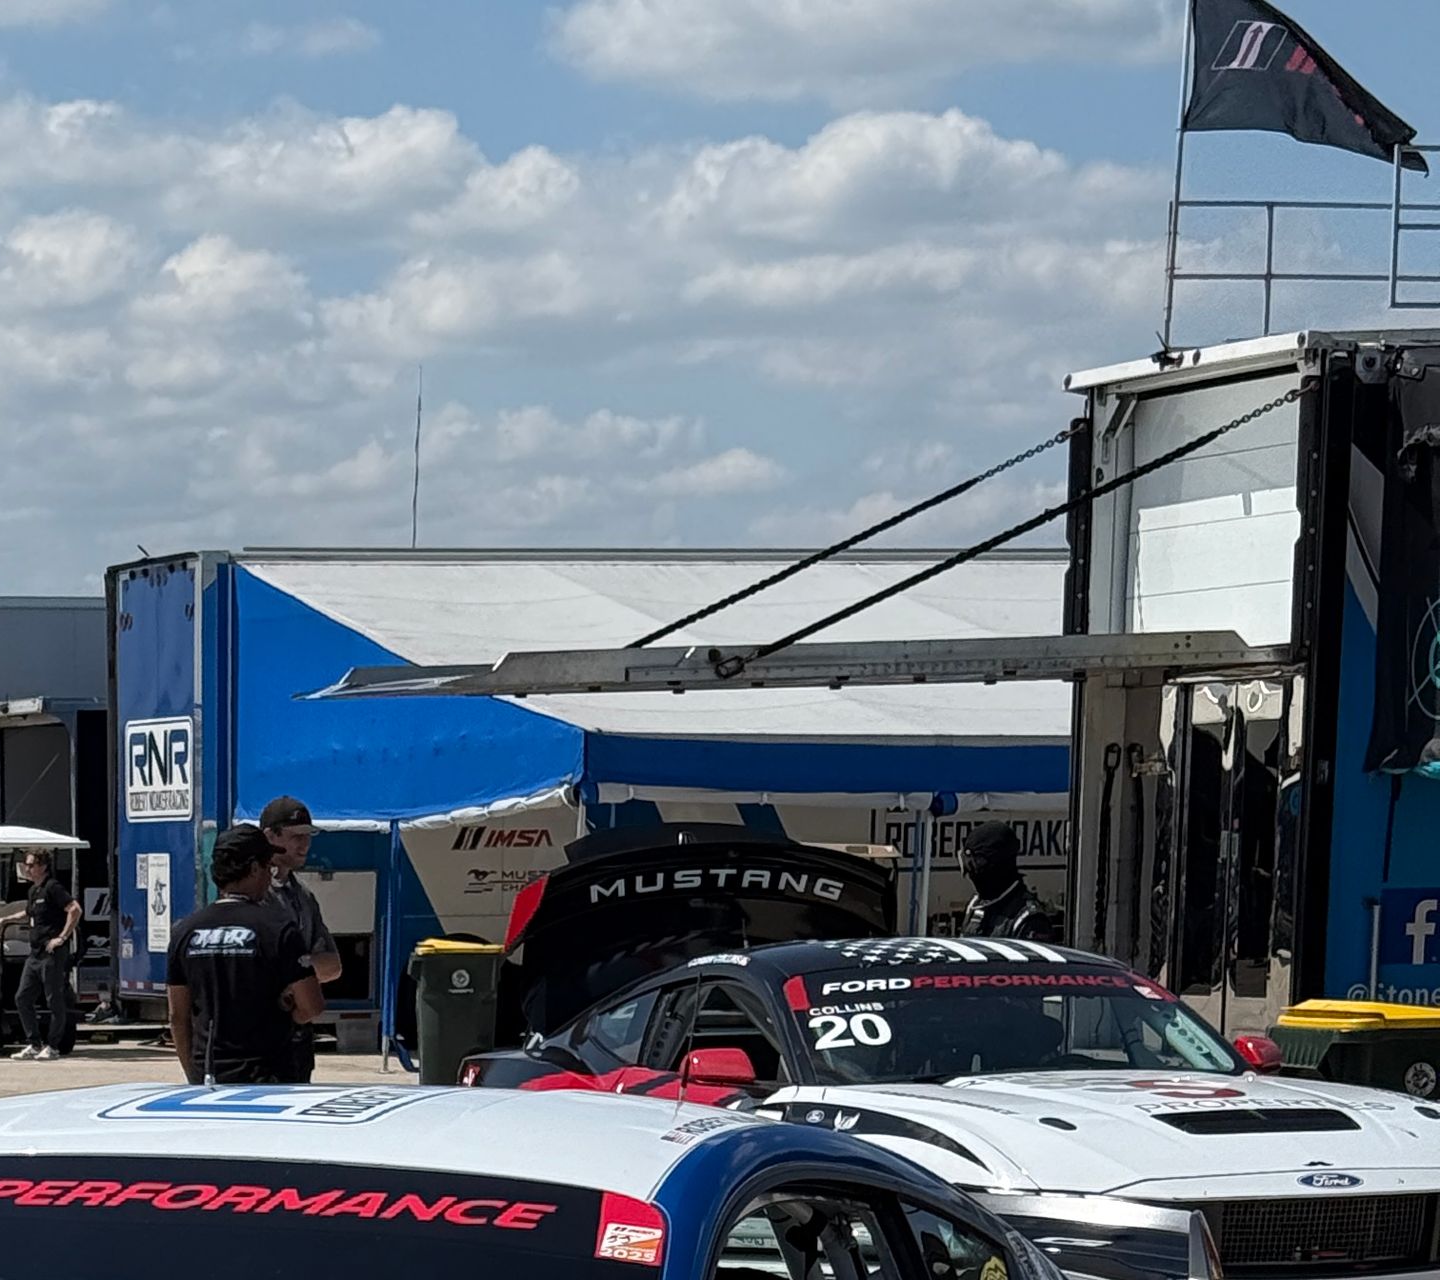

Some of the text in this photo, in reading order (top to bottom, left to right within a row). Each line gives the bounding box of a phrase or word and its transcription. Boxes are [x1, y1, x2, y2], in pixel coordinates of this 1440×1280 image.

[129, 728, 189, 788] RNR
[484, 829, 553, 848] IMSA
[589, 867, 845, 904] MUSTANG
[809, 1002, 885, 1016] COLLINS
[808, 1012, 893, 1052] 20
[1312, 1173, 1352, 1187] Ford
[598, 1248, 656, 1263] 2025
